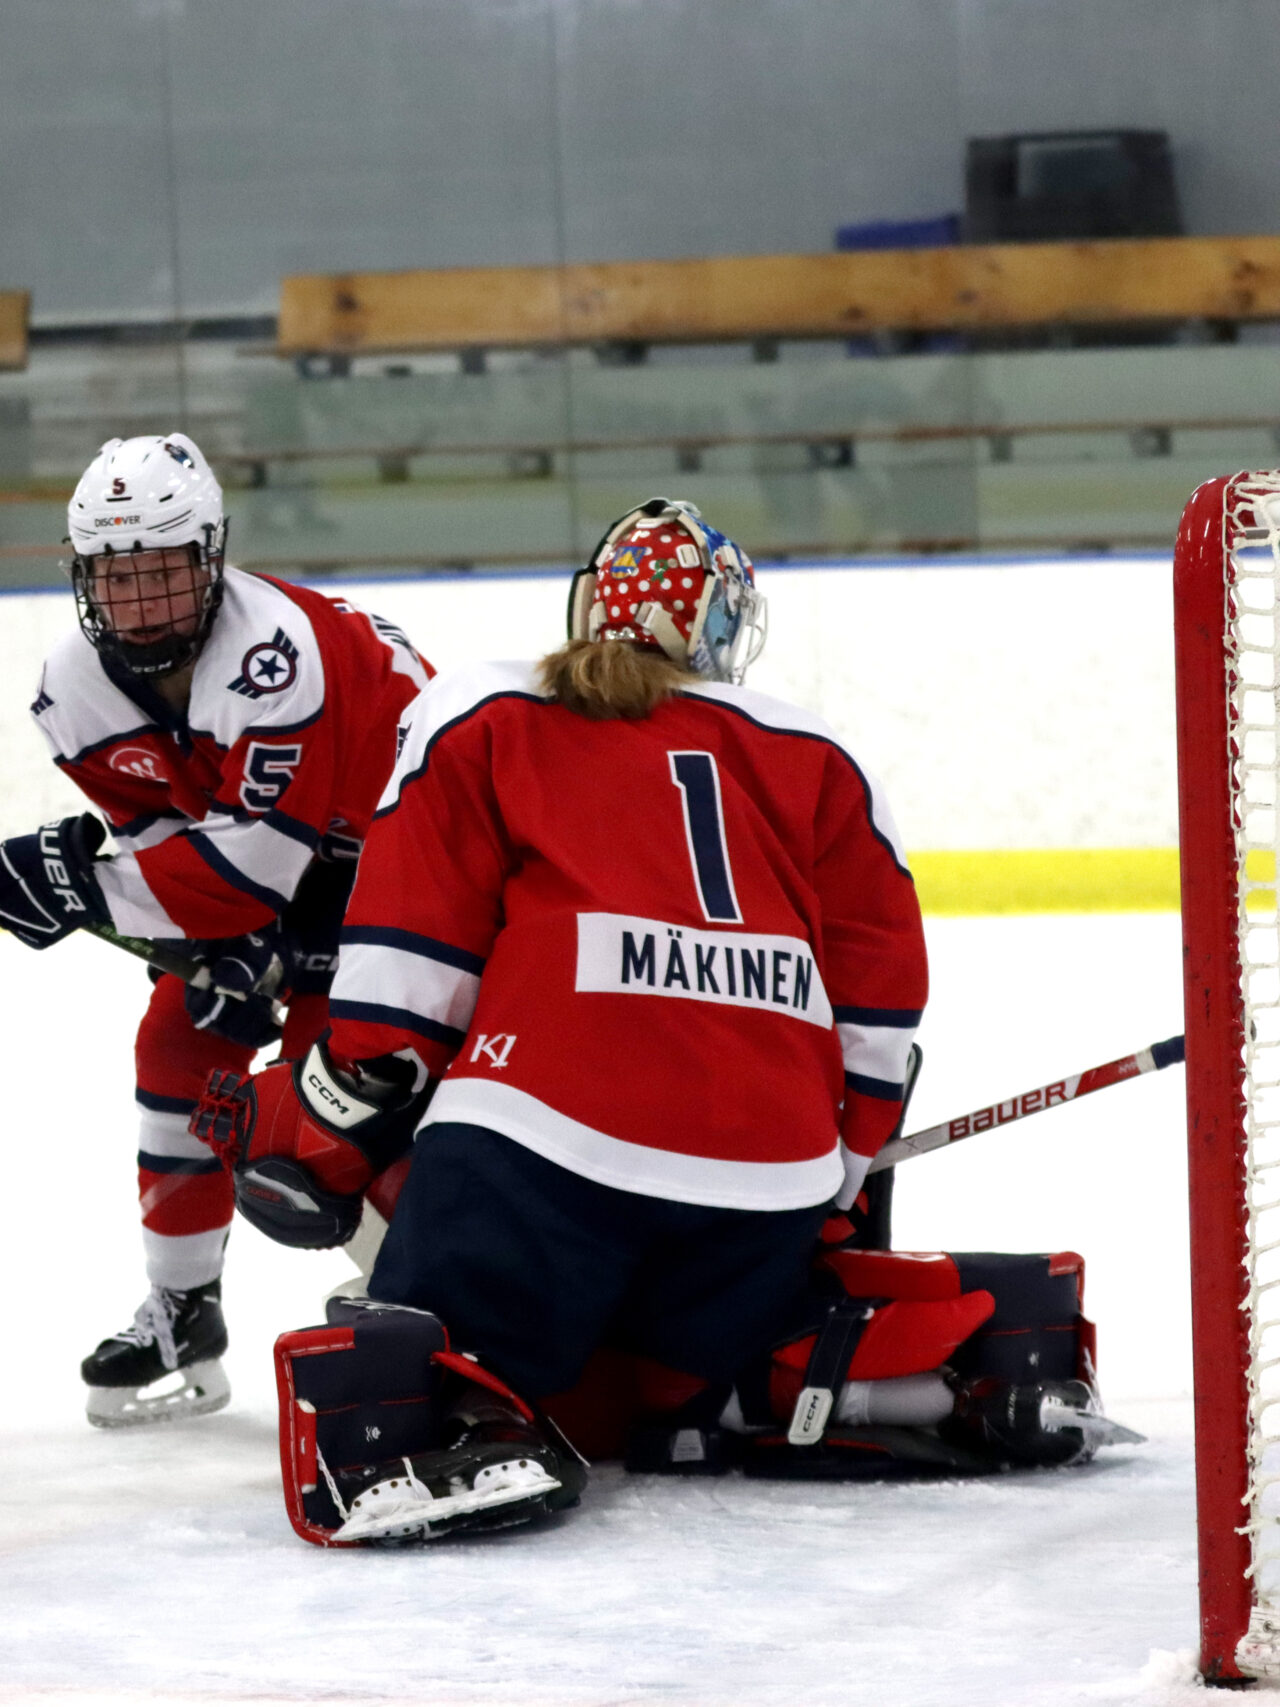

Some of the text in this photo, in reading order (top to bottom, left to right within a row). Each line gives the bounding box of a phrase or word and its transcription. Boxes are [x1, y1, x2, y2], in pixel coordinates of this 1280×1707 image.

[112, 477, 126, 496] 5
[94, 515, 141, 528] DISCOVER
[239, 741, 302, 812] 5
[667, 750, 744, 925] 1
[620, 928, 812, 1011] MÄKINEN
[308, 1074, 349, 1115] CCM
[949, 1081, 1067, 1142] BAUER
[803, 1394, 819, 1433] CCM
